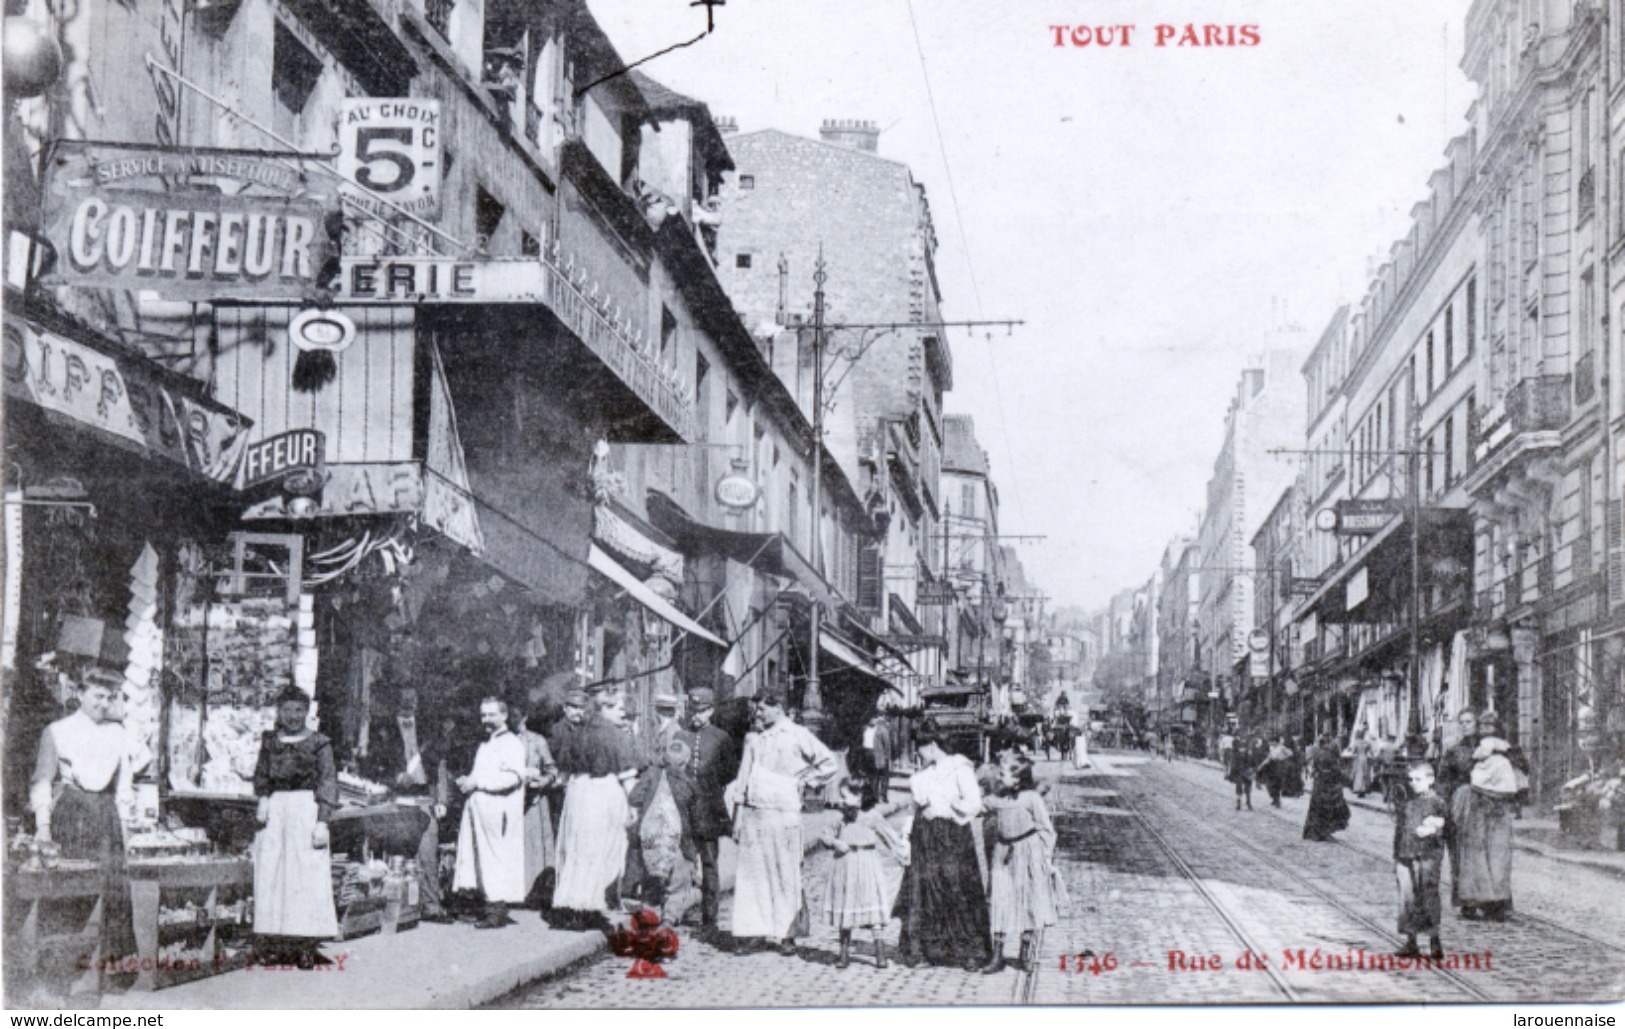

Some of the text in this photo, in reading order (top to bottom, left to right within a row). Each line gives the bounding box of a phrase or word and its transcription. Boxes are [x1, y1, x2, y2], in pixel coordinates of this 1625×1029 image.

[347, 104, 438, 125] AU CHOIX
[99, 155, 165, 183] SERVICE
[355, 126, 415, 193] 5
[69, 199, 314, 279] COIFFEUR
[334, 264, 477, 297] ERIE
